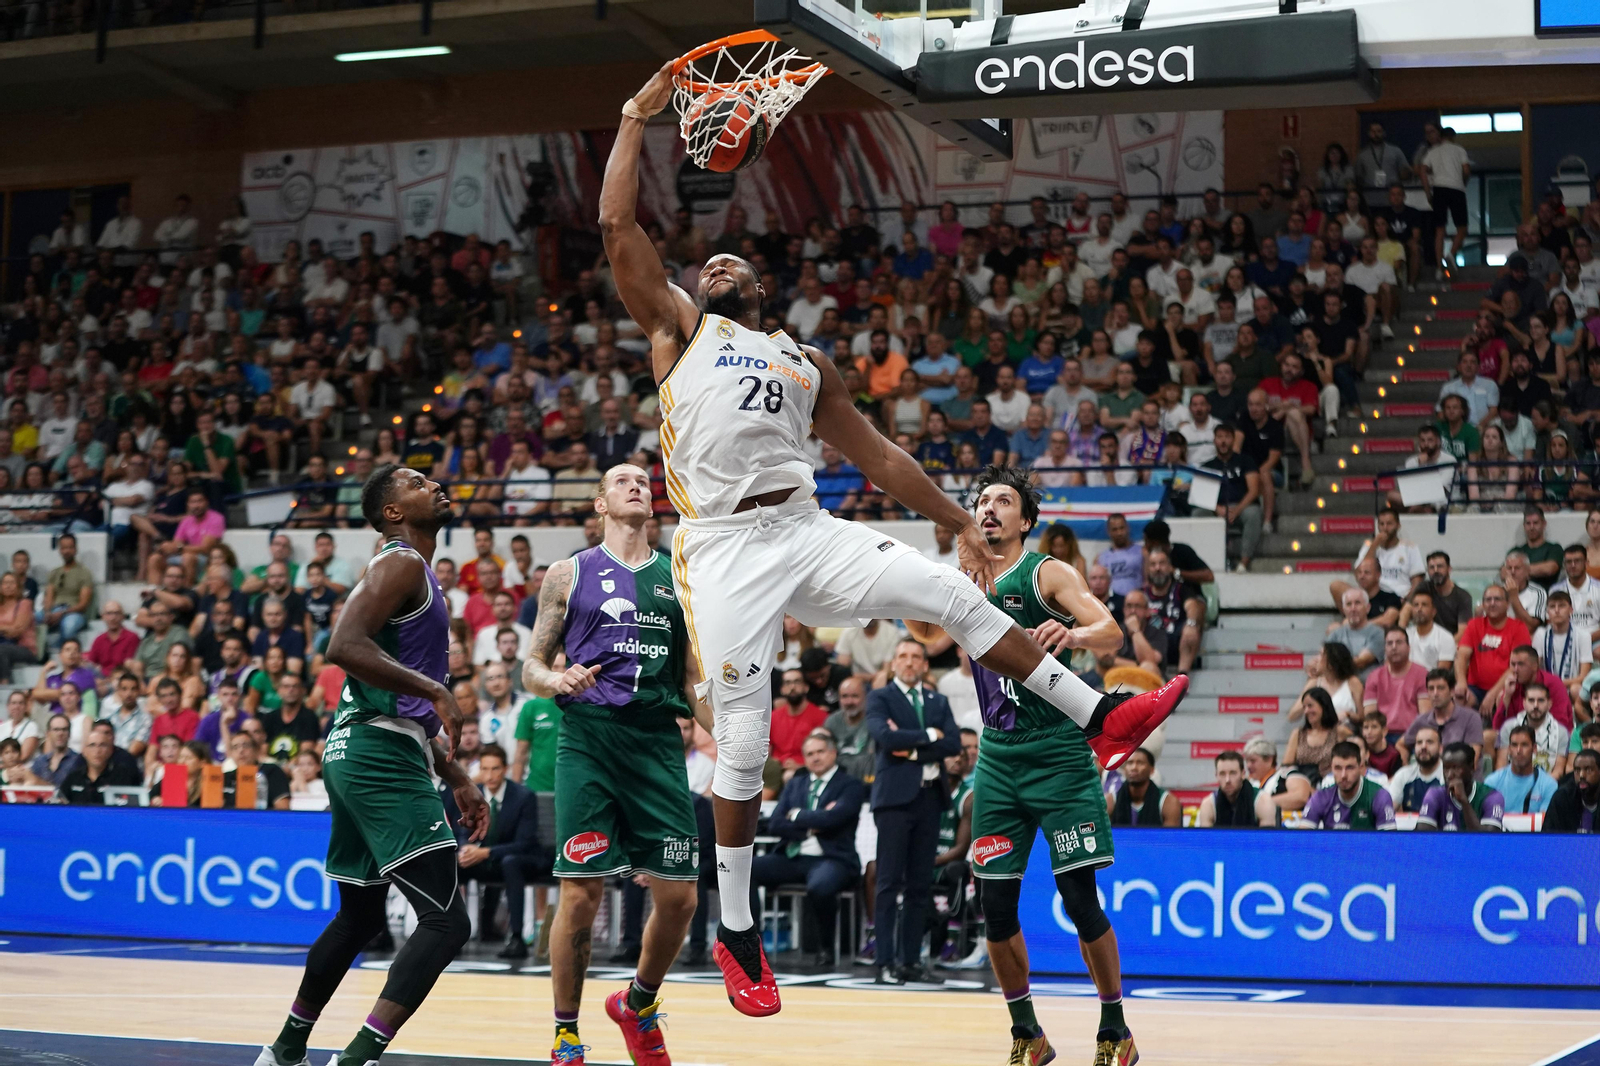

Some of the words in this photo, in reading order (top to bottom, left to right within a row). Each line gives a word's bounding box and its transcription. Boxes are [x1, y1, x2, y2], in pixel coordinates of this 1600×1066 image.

[975, 40, 1195, 95] endesa
[714, 355, 811, 391] AUTOHERO
[738, 375, 784, 414] 28
[613, 637, 669, 659] málaga
[998, 676, 1020, 706] 14
[568, 834, 609, 857] famadesa
[60, 838, 332, 911] endesa
